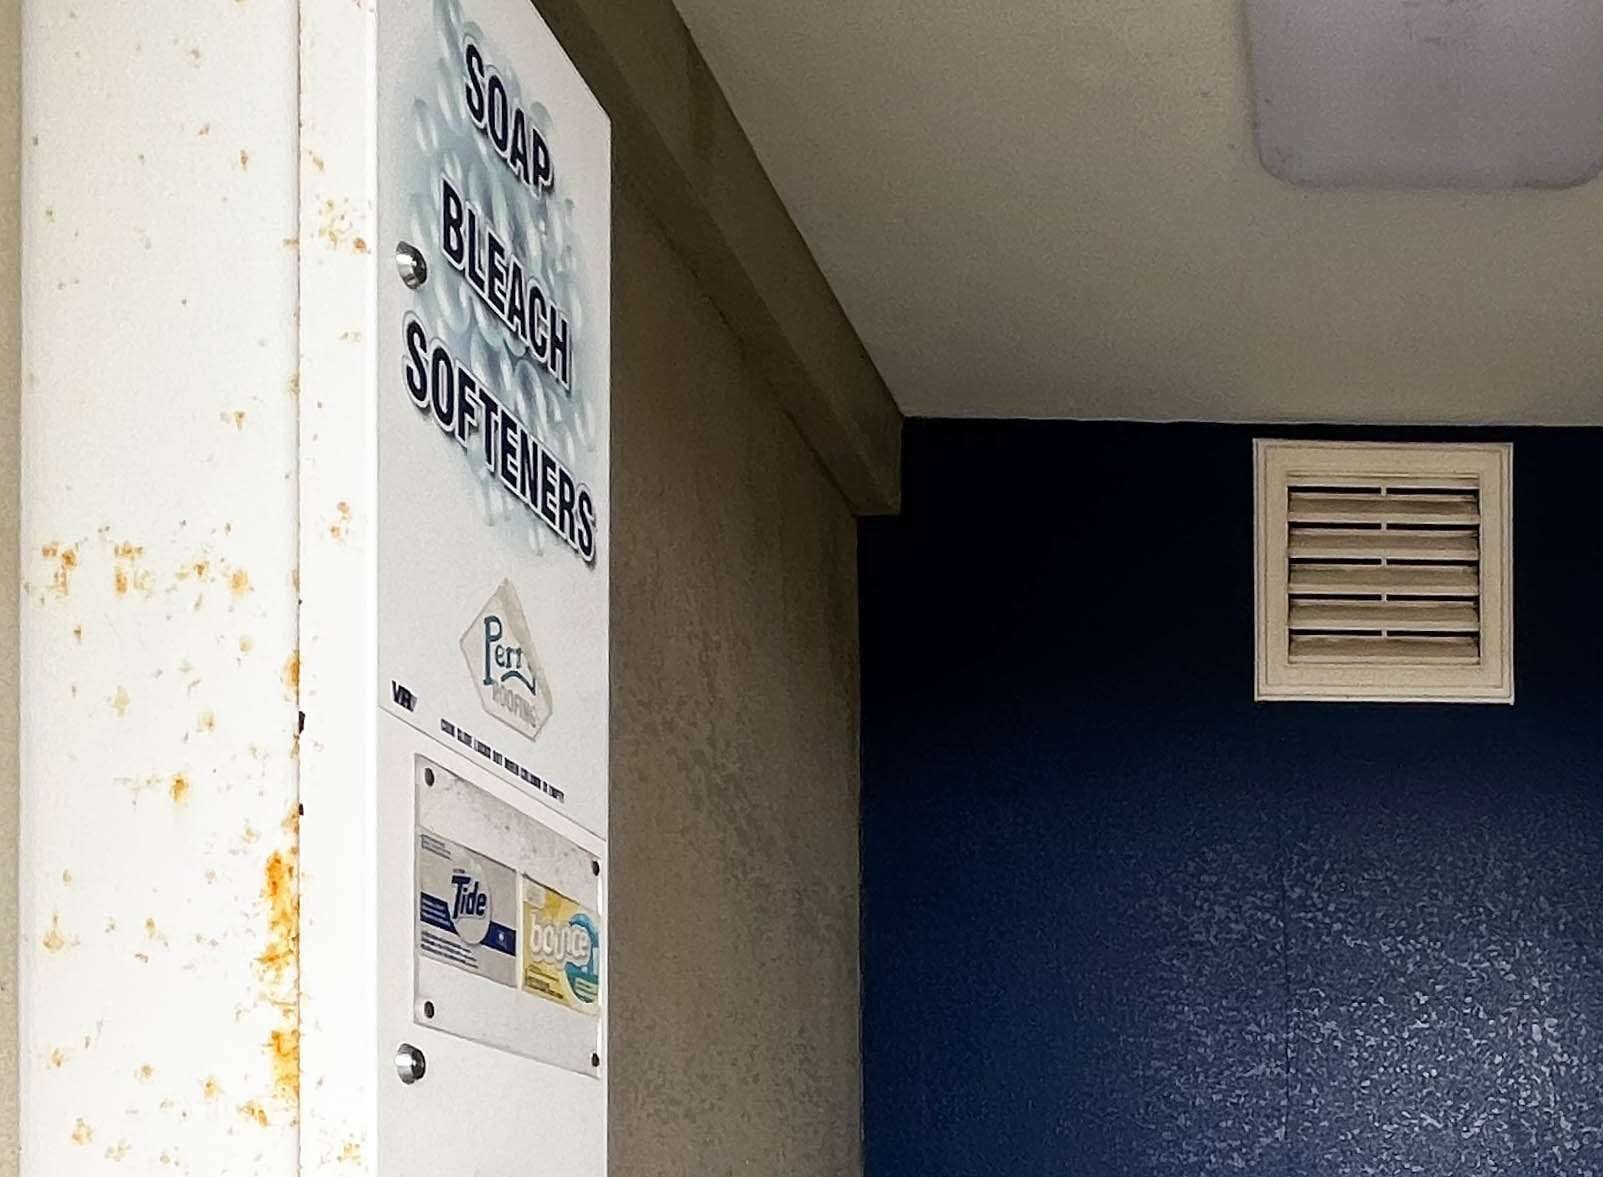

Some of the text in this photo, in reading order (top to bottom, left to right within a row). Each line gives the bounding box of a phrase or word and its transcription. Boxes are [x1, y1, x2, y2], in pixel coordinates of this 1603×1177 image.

[464, 43, 553, 189] SOAP
[441, 177, 571, 388] BLEACH
[405, 319, 595, 562] SOFTENERS
[452, 875, 487, 919] Tide
